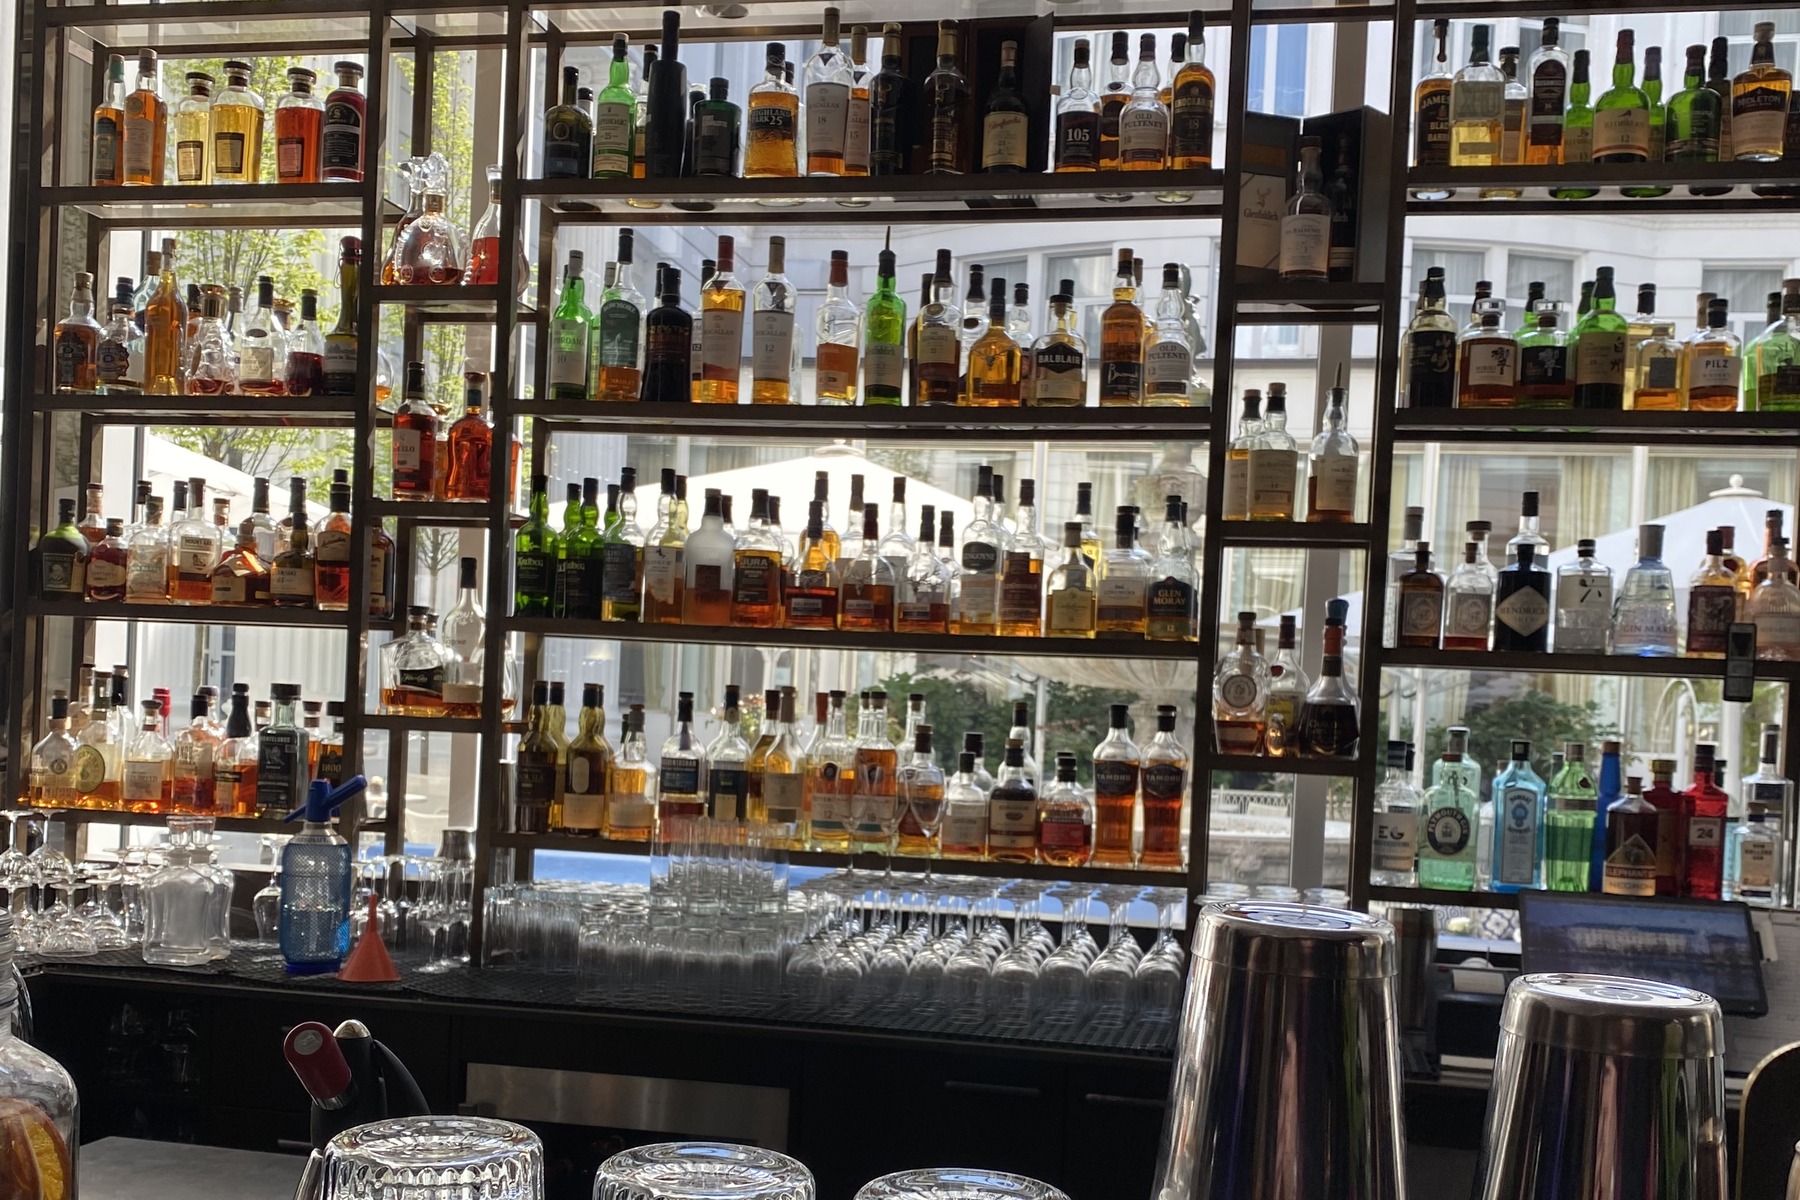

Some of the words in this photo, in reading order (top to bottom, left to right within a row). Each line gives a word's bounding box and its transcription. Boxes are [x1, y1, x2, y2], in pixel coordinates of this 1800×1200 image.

[1737, 95, 1781, 107] MIDLETON
[752, 108, 791, 118] HIGHLAND
[1134, 112, 1153, 120] OLD
[751, 116, 769, 124] PARK
[769, 115, 784, 126] 25
[817, 116, 828, 125] 18
[1123, 120, 1163, 130] PULTENEY
[1430, 121, 1450, 131] BLAC
[850, 130, 860, 139] 15
[1066, 128, 1091, 142] 105
[1620, 134, 1631, 144] 12
[764, 343, 776, 353] 12
[1159, 345, 1177, 353] OLD
[1037, 354, 1082, 365] BALBLAIR
[1148, 352, 1188, 362] PULTENEY
[1704, 359, 1729, 369] PILZ
[516, 556, 544, 567] Ardbeg
[739, 558, 770, 568] JURA
[1157, 589, 1182, 598] GLEN
[1153, 597, 1186, 606] MORAY
[1166, 624, 1176, 633] 12
[1622, 625, 1642, 633] GIN
[321, 762, 342, 773] 1800
[1096, 773, 1132, 782] TAMDHU
[1145, 774, 1181, 783] TAMDHU
[1509, 794, 1533, 805] BOMBAY
[1427, 807, 1463, 834] PLYMOUTH
[1696, 828, 1714, 839] 24
